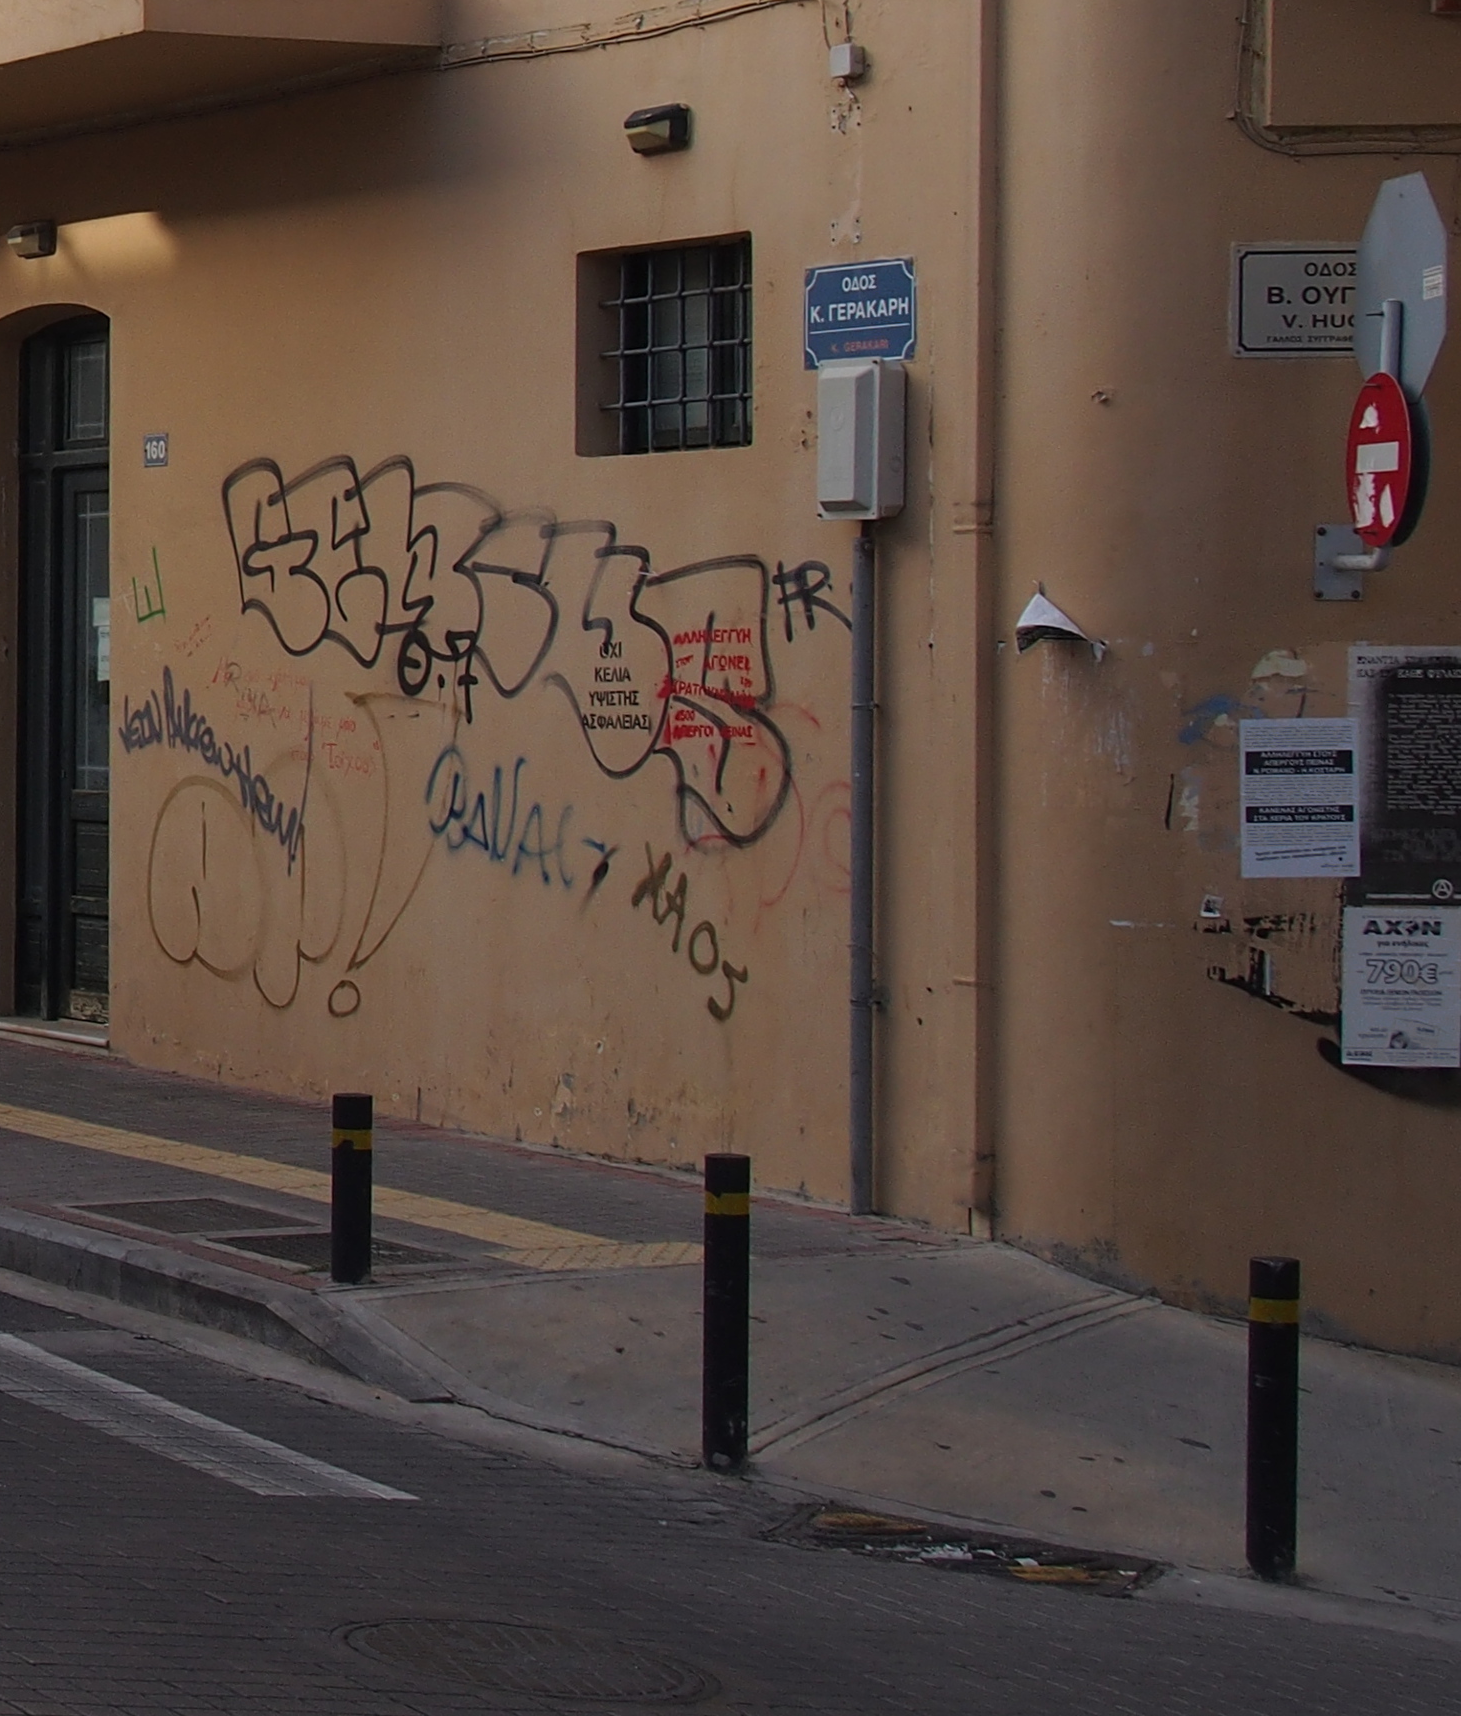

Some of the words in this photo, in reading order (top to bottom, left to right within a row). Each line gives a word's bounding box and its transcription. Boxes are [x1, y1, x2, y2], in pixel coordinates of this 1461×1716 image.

[1304, 262, 1357, 277] ΟΔΟΣ
[841, 274, 878, 293] ΟΔΟΣ
[1267, 286, 1292, 305] Β.
[1302, 286, 1356, 305] ΟΥΓ
[810, 305, 825, 324] Κ.
[828, 296, 910, 322] ΓΕΡΑΚΑΡΗ
[1281, 314, 1303, 328] V.
[1307, 335, 1354, 343] ΣΥΓΓΡΑΦΕ
[145, 441, 166, 459] 160
[594, 667, 631, 683] ΚΕΛΙΑ
[588, 690, 640, 707] ΥΨΙΣΤΗΣ
[582, 713, 651, 730] ΑΣΦΑΛΕΙΑΣ
[1366, 959, 1439, 984] 790€
